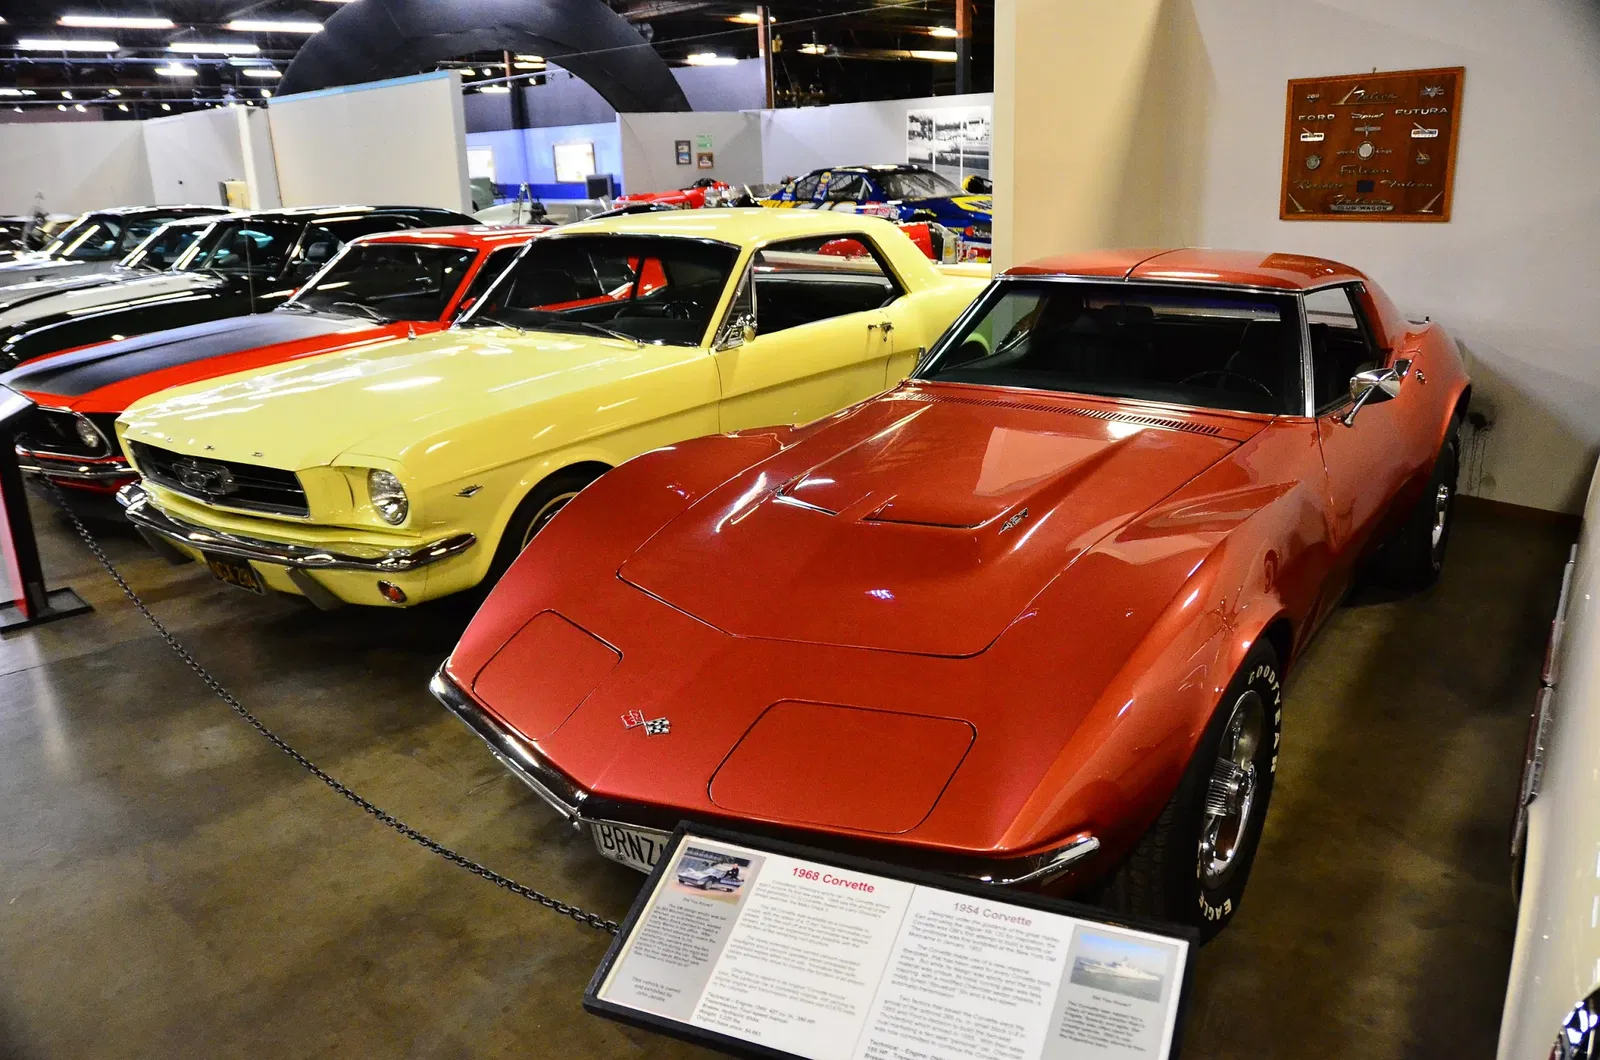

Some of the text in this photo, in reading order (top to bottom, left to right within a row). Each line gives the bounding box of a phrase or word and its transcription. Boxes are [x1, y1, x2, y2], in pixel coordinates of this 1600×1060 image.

[1298, 113, 1336, 121] FORD
[1394, 107, 1448, 115] FUTURA
[1248, 664, 1282, 773] GOODYEAR
[601, 823, 666, 868] BRNZ
[792, 866, 876, 893] 1968 Corvette
[953, 902, 1033, 927] 1954 Corvette
[1198, 889, 1232, 922] EAGLE
